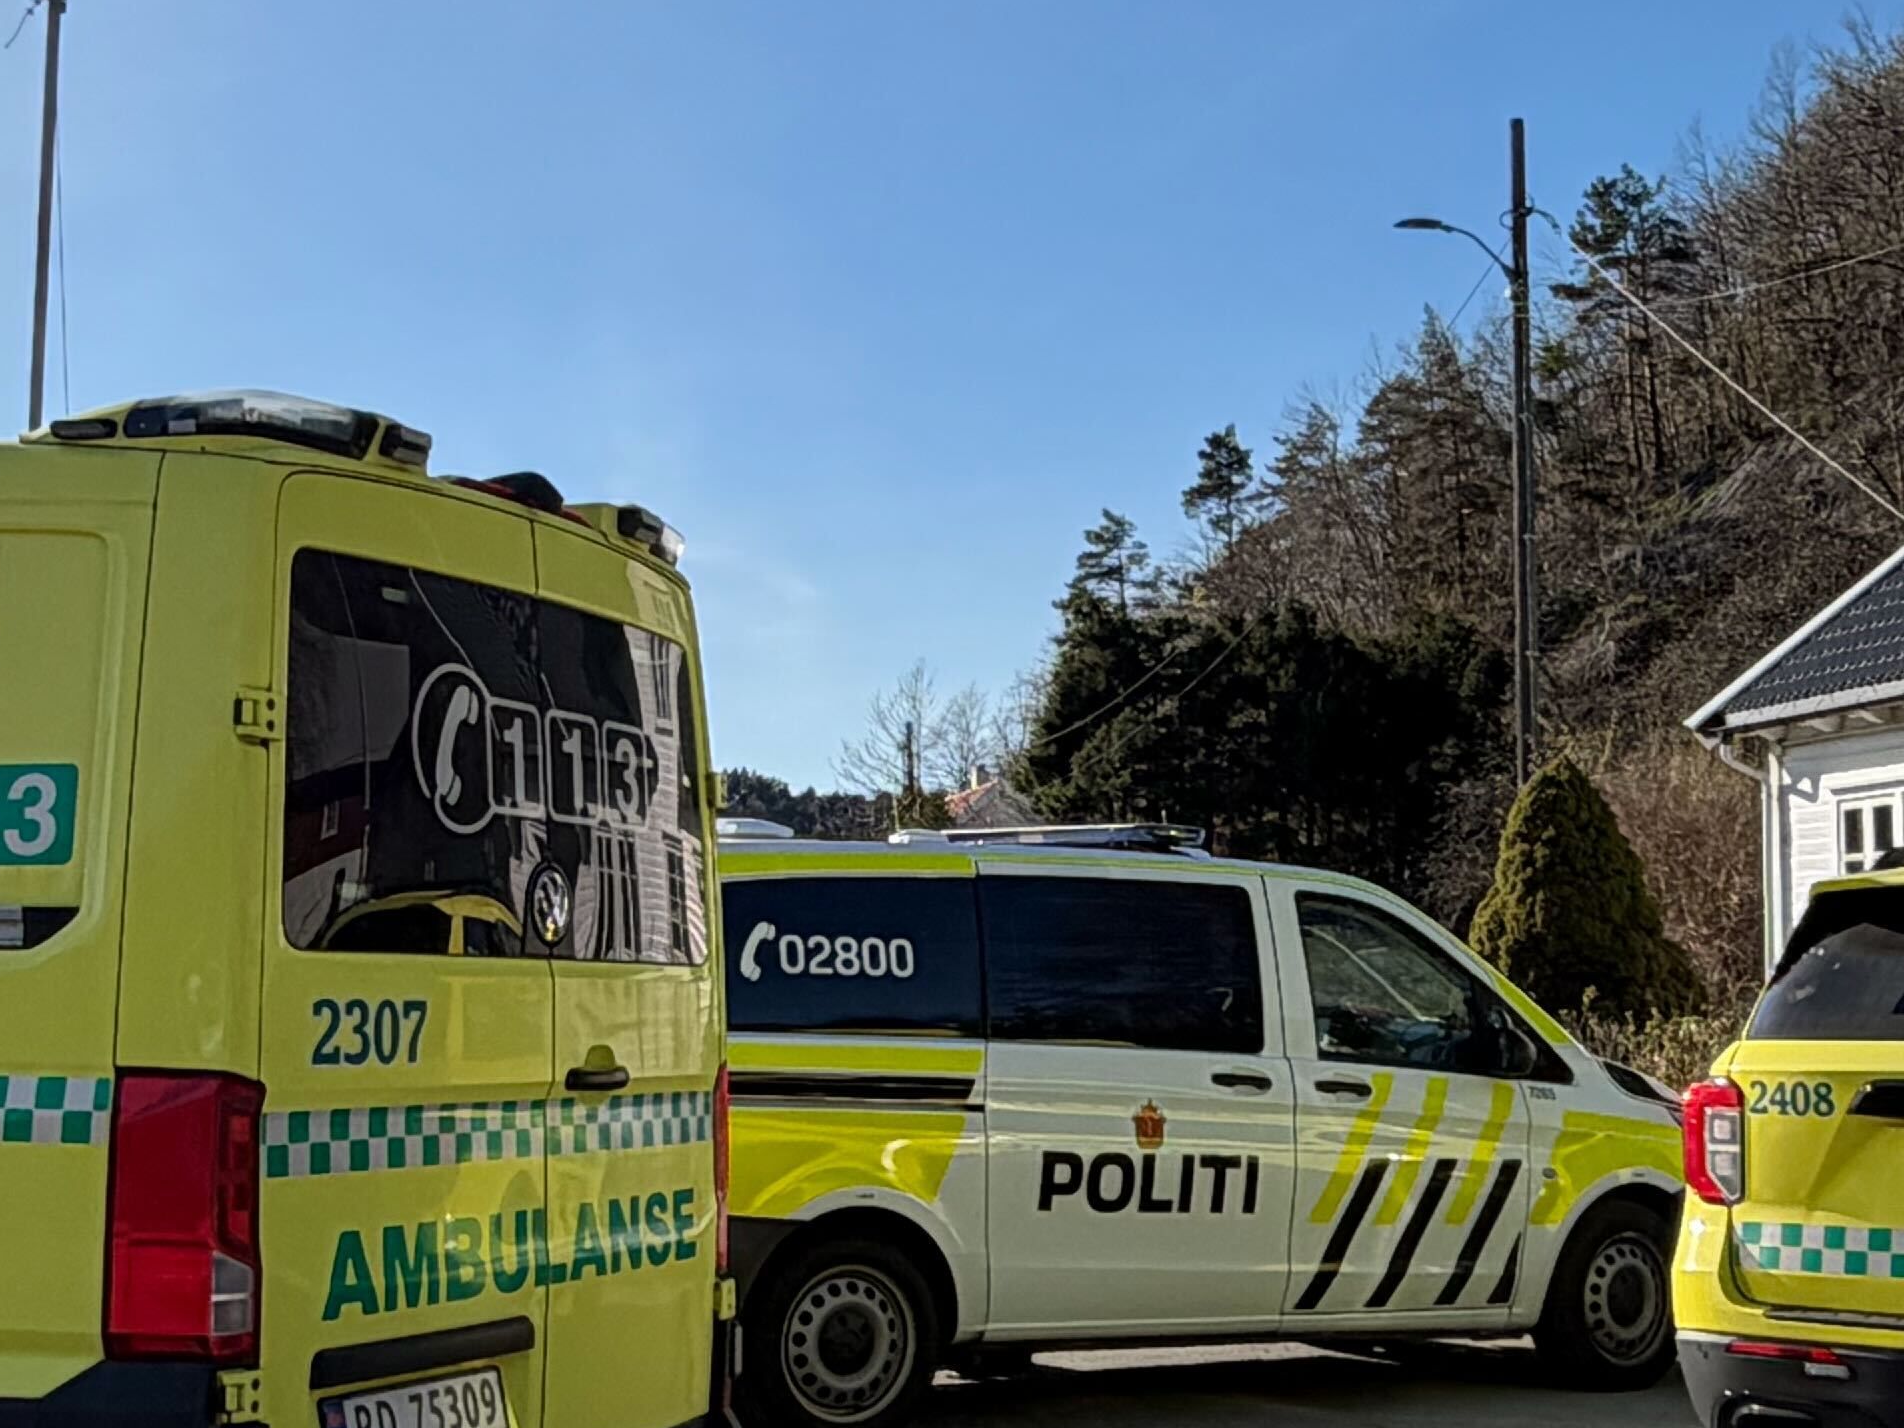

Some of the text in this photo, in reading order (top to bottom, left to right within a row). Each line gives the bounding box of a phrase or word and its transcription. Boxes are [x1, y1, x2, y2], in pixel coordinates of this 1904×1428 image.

[778, 934, 915, 978] 02800
[309, 997, 429, 1066] 2307
[1748, 1079, 1835, 1117] 2408
[1037, 1149, 1260, 1214] POLITI
[321, 1187, 696, 1321] AMBULANSE
